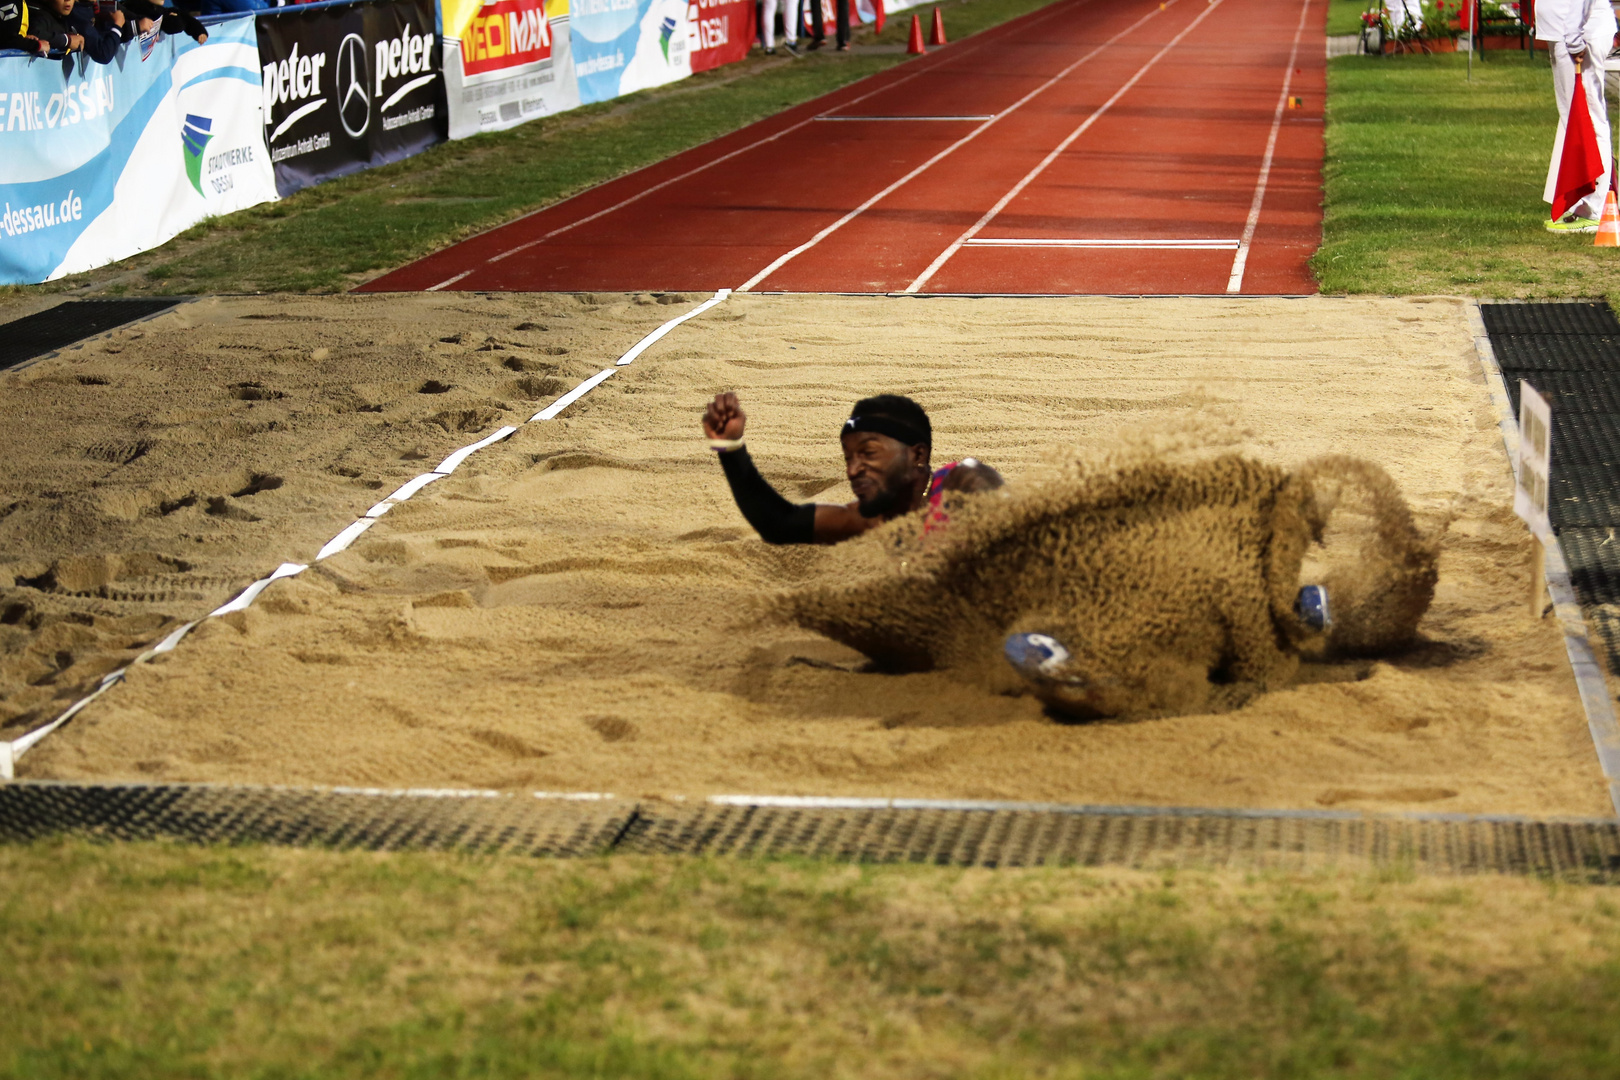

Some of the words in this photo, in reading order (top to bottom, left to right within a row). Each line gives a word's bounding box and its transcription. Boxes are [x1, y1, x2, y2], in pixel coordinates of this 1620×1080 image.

[374, 22, 434, 98] peter
[463, 7, 550, 63] MEDIMAX
[45, 74, 114, 128] DESSAU
[262, 42, 326, 125] peter
[208, 145, 254, 175] STADTWERKE
